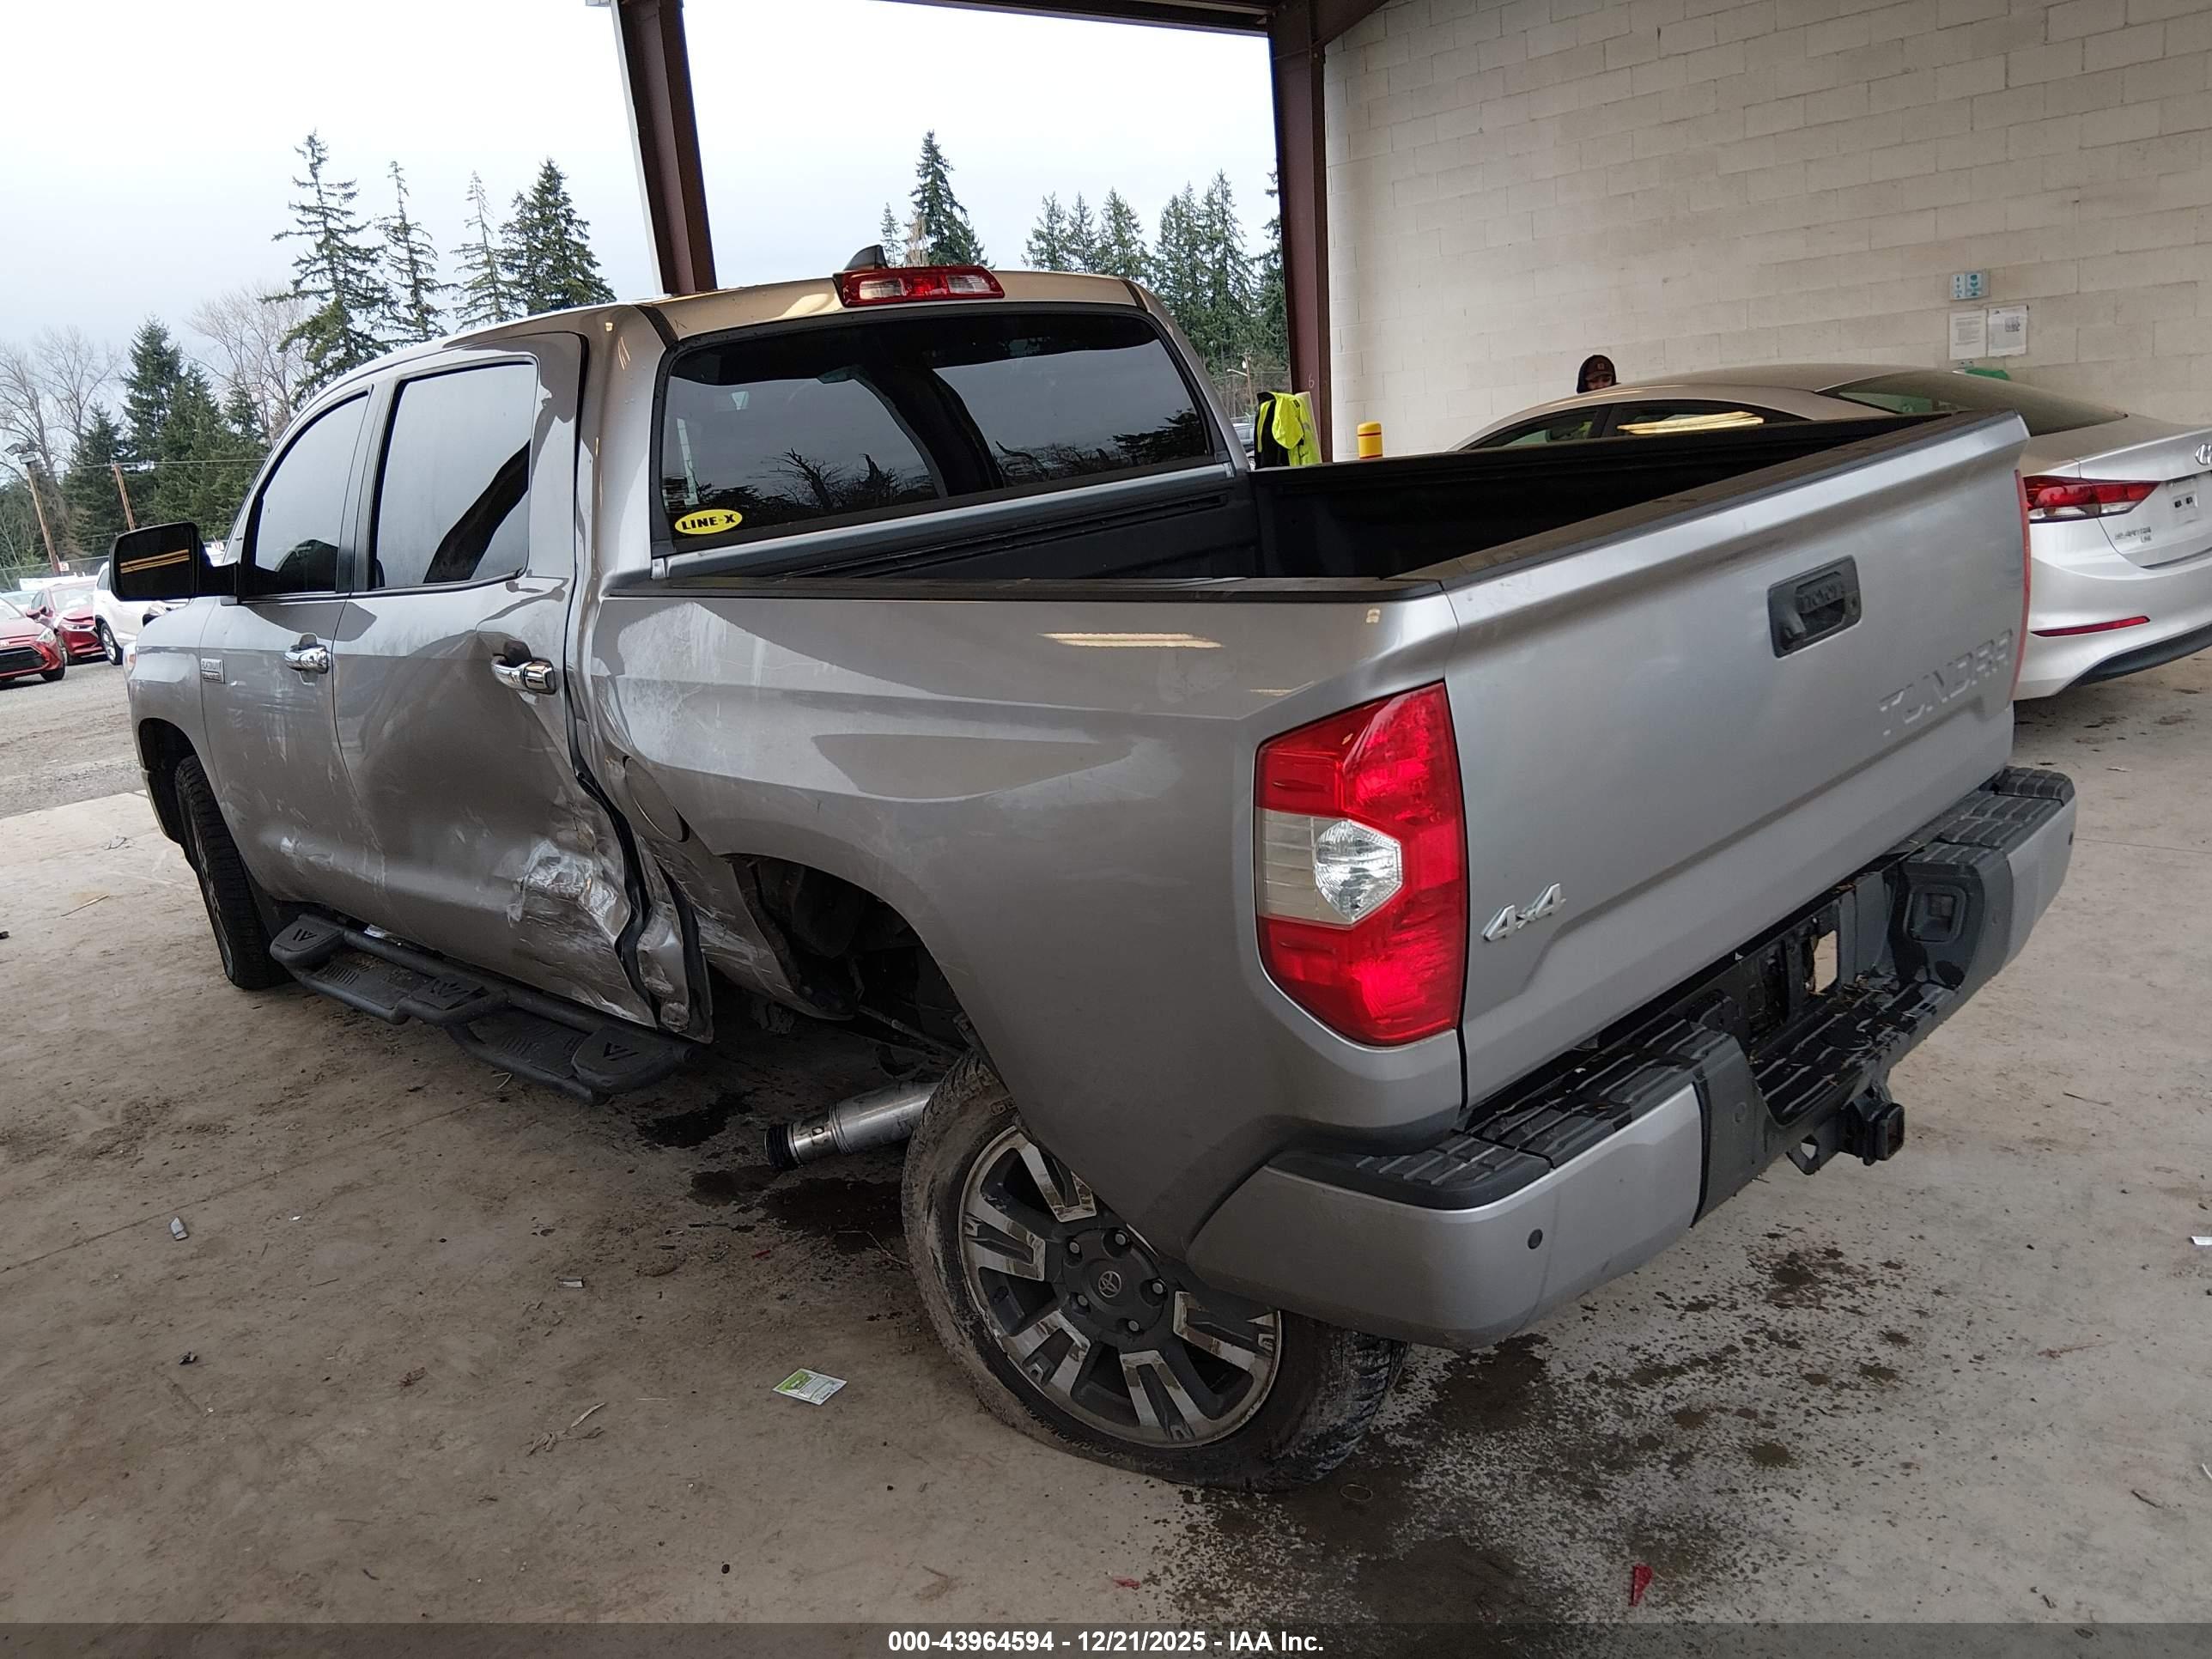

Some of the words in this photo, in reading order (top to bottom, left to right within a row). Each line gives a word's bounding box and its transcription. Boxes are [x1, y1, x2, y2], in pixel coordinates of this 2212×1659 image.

[1308, 373, 1315, 389] 6
[681, 514, 736, 531] LINE-X
[1879, 628, 2014, 736] TUNDRA
[1481, 882, 1566, 941] 4x4
